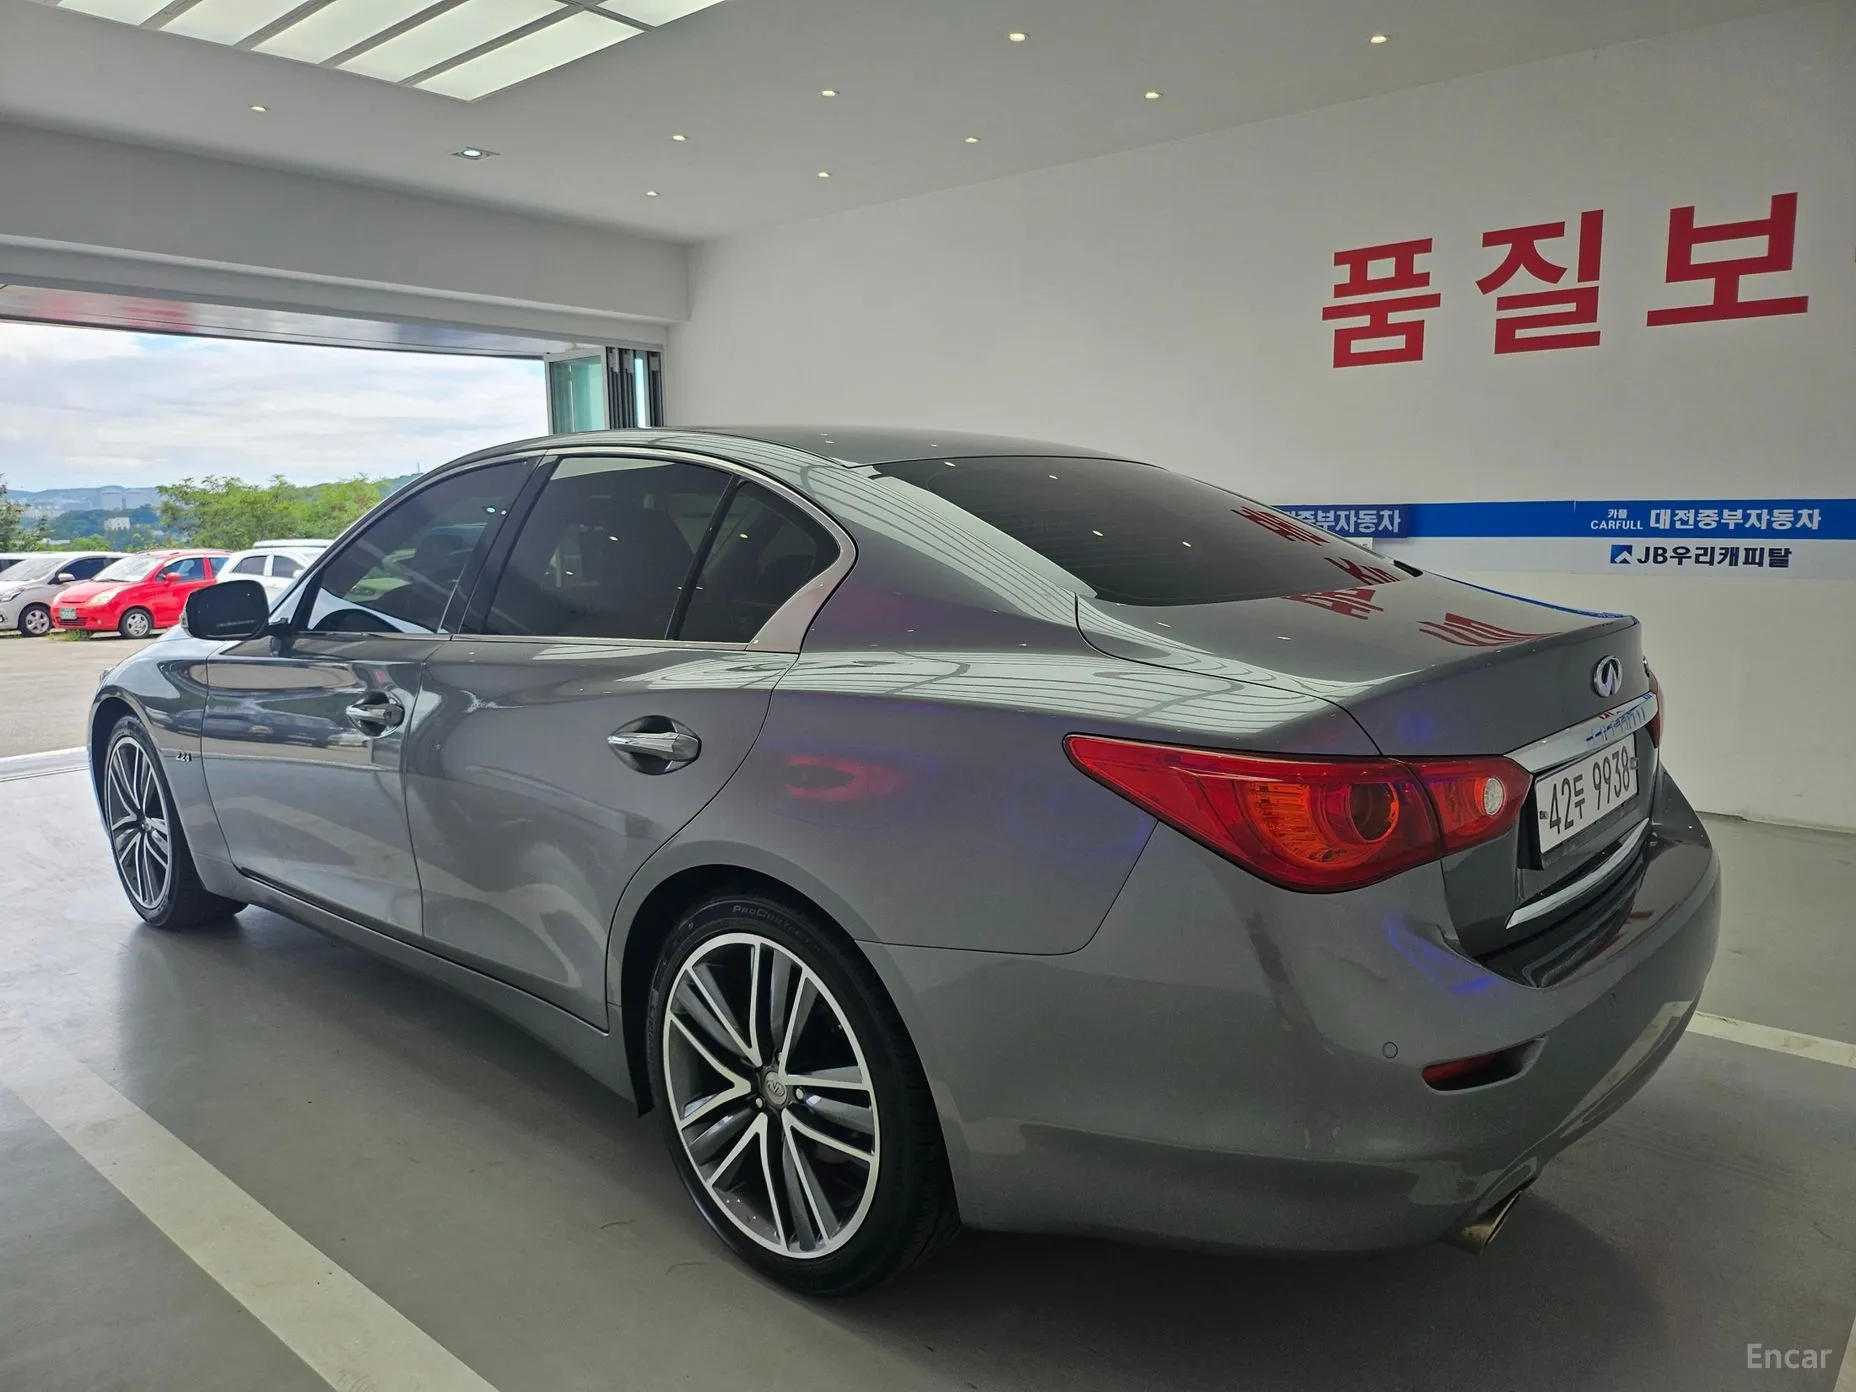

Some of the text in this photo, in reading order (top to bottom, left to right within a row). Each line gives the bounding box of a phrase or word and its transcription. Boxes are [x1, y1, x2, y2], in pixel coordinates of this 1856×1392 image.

[1590, 519, 1643, 530] CARFULL
[1649, 508, 1822, 530] 대전중부자동차
[1636, 546, 1792, 568] JB우리캐피탈
[1592, 745, 1630, 811] 9938
